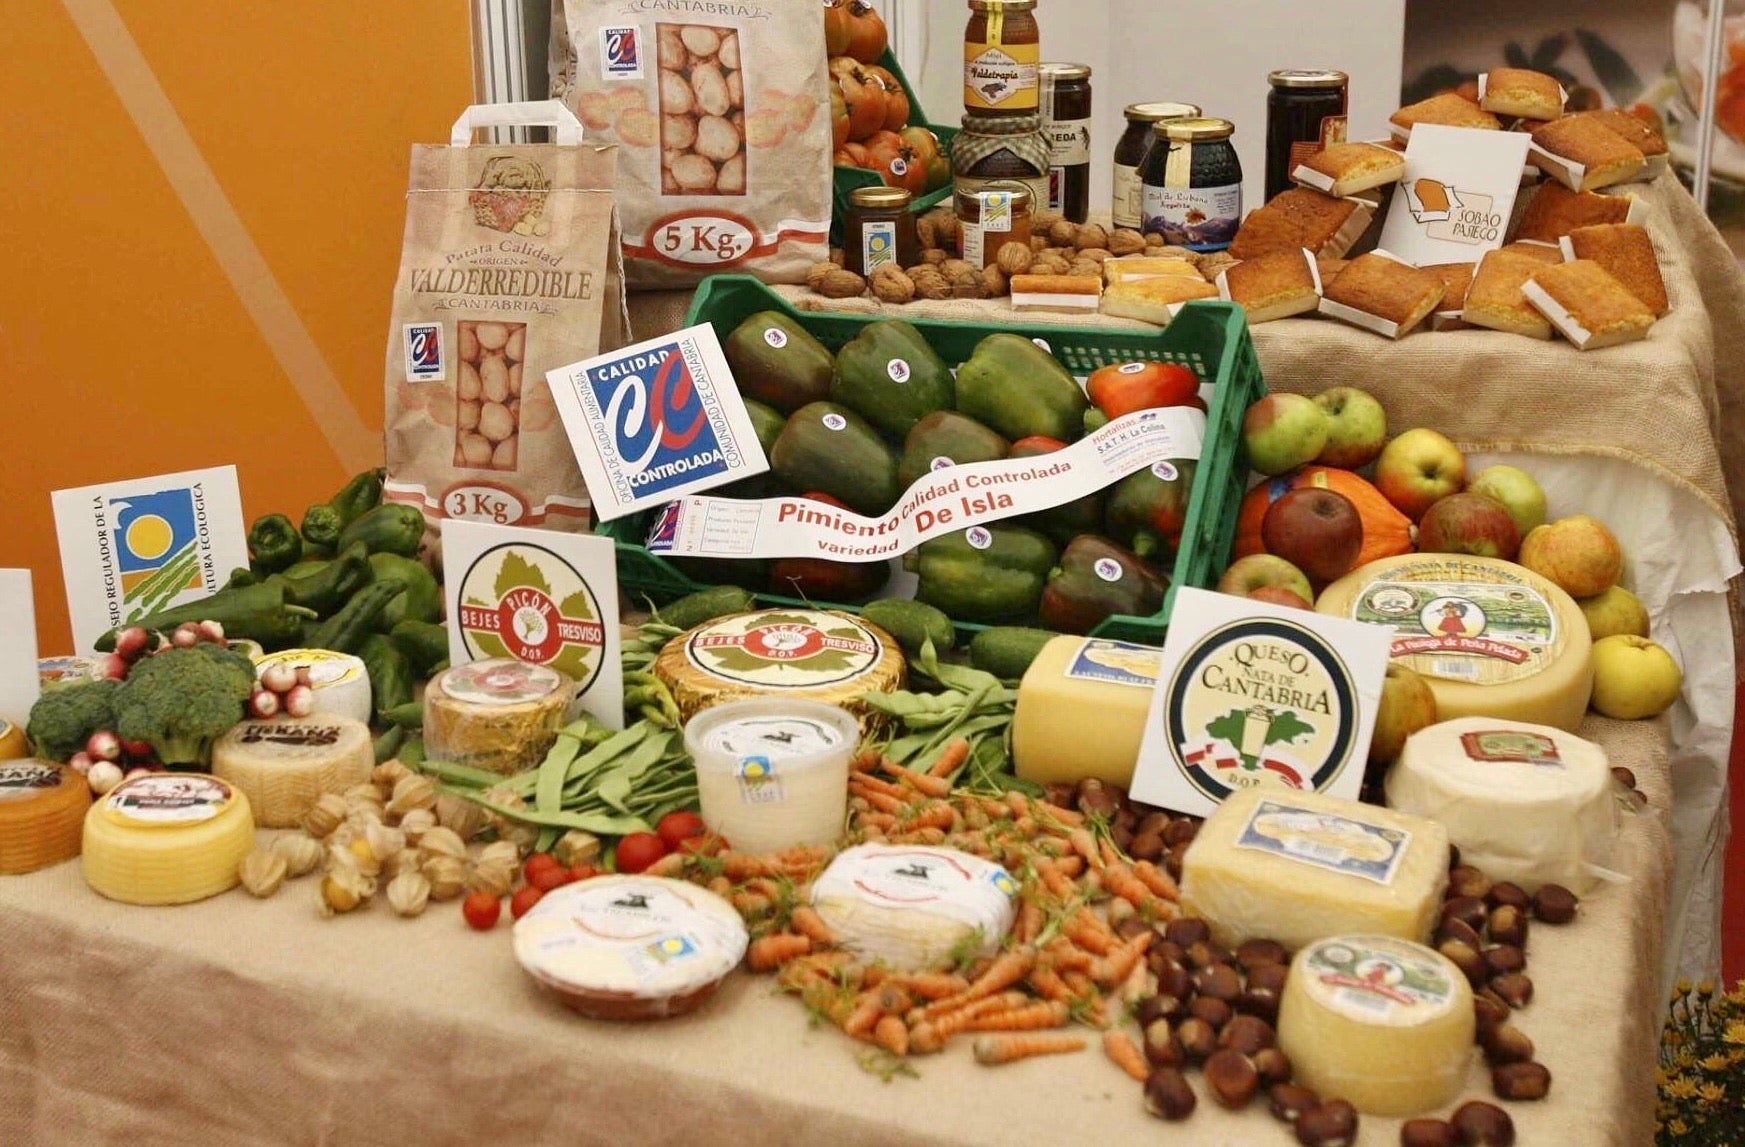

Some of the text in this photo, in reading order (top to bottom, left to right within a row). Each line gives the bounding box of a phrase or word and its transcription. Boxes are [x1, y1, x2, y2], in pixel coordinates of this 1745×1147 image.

[640, 0, 749, 16] CANTABRIA
[1458, 209, 1501, 227] SOBAO
[445, 239, 565, 268] Patata Calidad
[664, 226, 742, 259] 5 Kg.
[478, 257, 519, 266] ORIGEN
[410, 267, 593, 301] VALDERREDIBLE
[448, 299, 540, 312] CANTABRIA
[598, 350, 670, 382] CALIDAD
[683, 339, 741, 469] COMUNIDAD DE CANTABRIA
[573, 370, 632, 503] OFICINA DE CALIDAD ALIMENTARIA
[1130, 429, 1141, 438] La
[628, 448, 724, 488] CONTROLADA
[93, 494, 105, 510] LA
[452, 493, 508, 525] 3 Kg
[778, 502, 900, 538] Pimiento
[965, 460, 1073, 490] Controlada
[95, 511, 106, 527] DE
[192, 482, 212, 551] ECOLOGICA
[817, 490, 1014, 557] variedad De Isla
[97, 530, 118, 600] REGULADOR
[506, 590, 553, 617] PICÓN
[461, 610, 602, 643] BEJES TRESVISO
[694, 635, 875, 654] BEJES TRESVISO
[1234, 642, 1309, 675] QUESO
[1202, 664, 1332, 715] CANTABRIA
[1243, 666, 1296, 687] NATA DE
